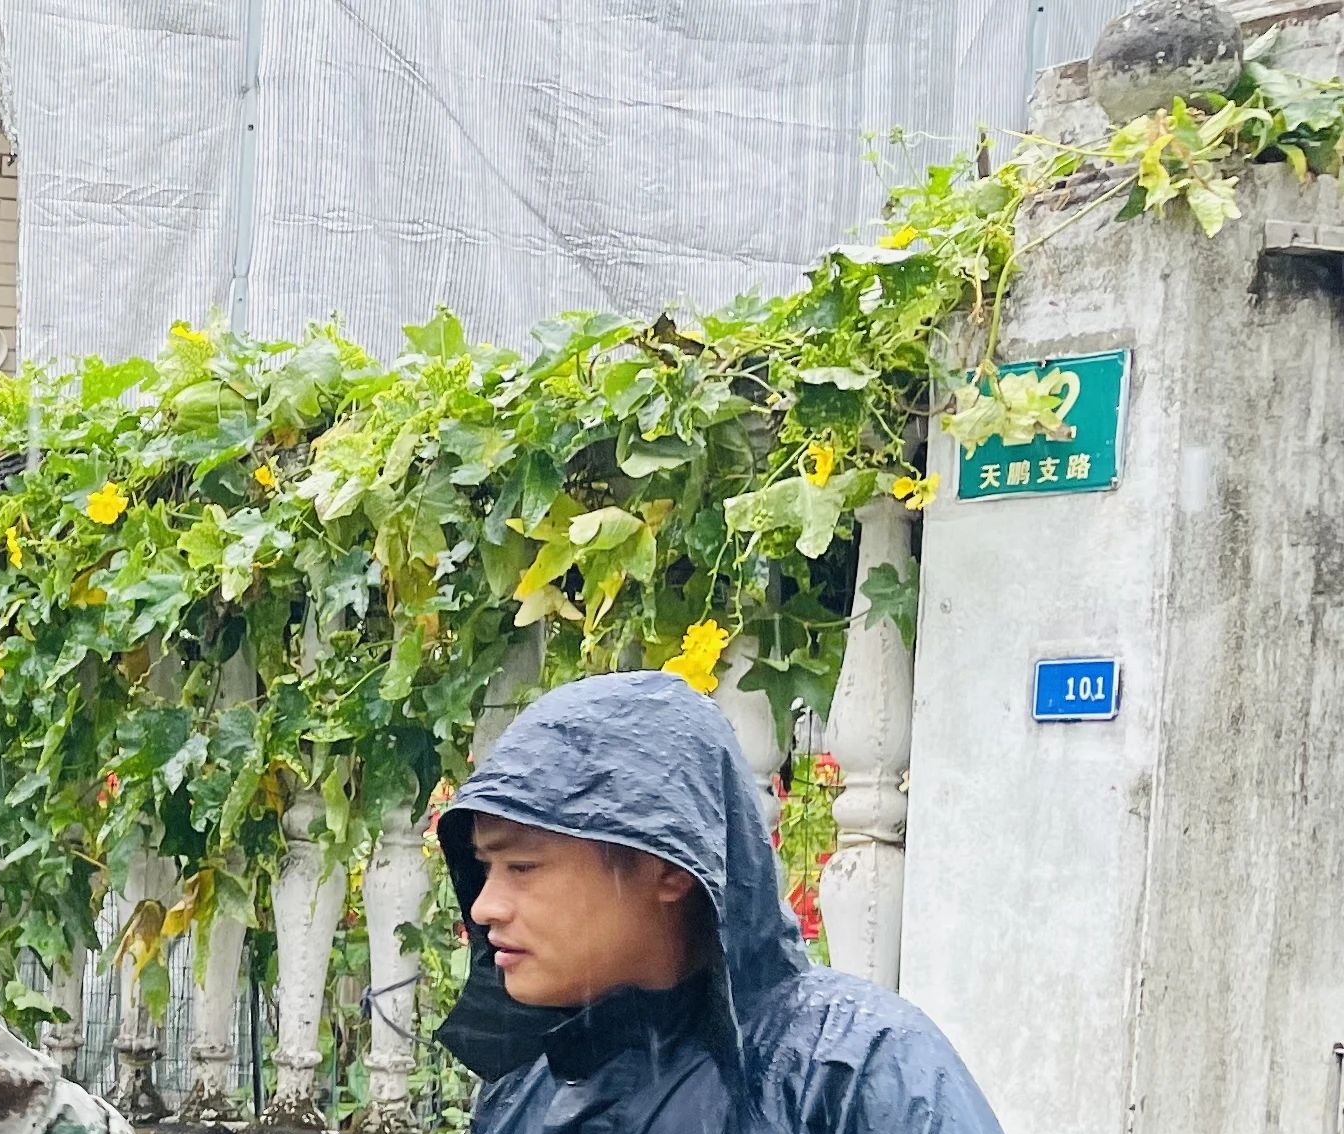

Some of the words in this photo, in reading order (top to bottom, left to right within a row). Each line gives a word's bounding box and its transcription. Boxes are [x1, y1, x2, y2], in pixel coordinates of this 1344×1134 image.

[978, 453, 1091, 490] 天鹏支路
[1064, 676, 1106, 702] 101
